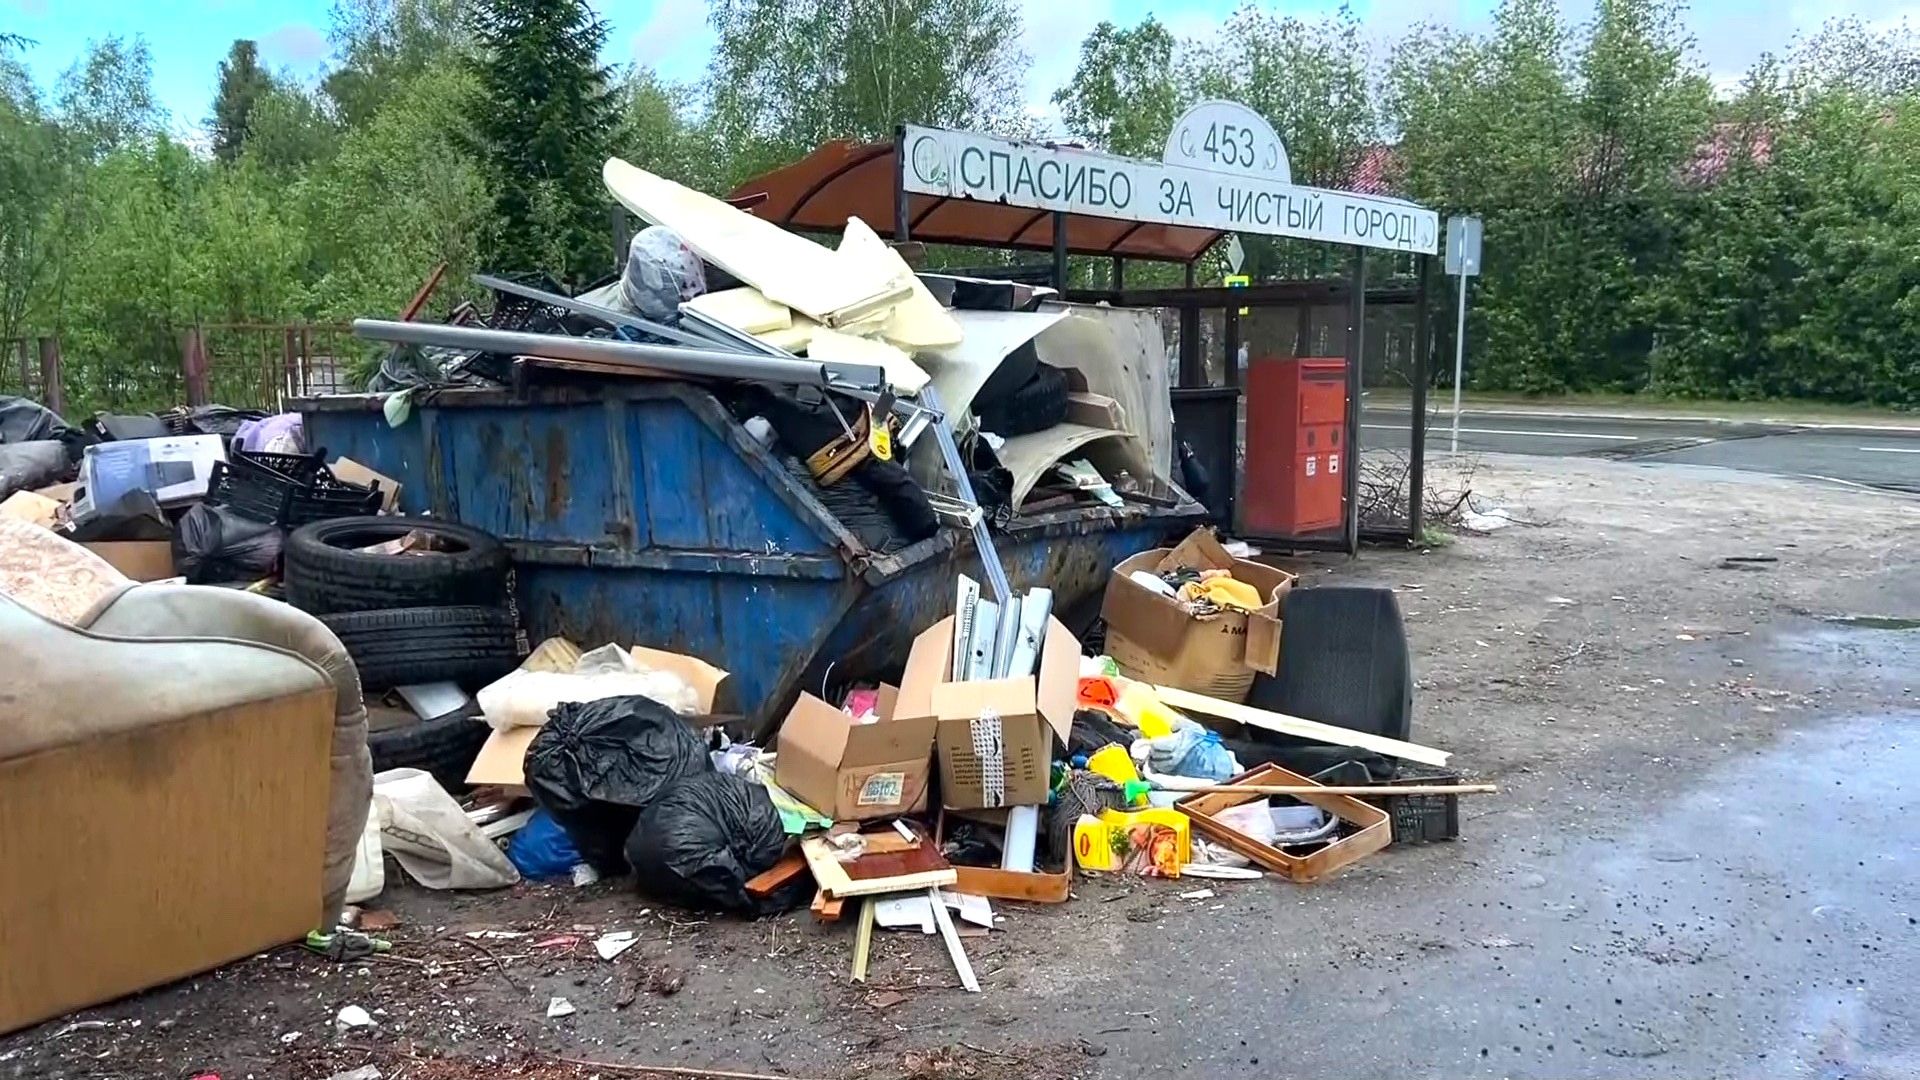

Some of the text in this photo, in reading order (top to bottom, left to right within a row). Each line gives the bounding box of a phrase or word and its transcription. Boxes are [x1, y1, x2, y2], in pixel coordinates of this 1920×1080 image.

[1203, 121, 1255, 168] 453
[960, 146, 1416, 249] СПАСИБО ЗА ЧИСТЫЙ ГОРОД!
